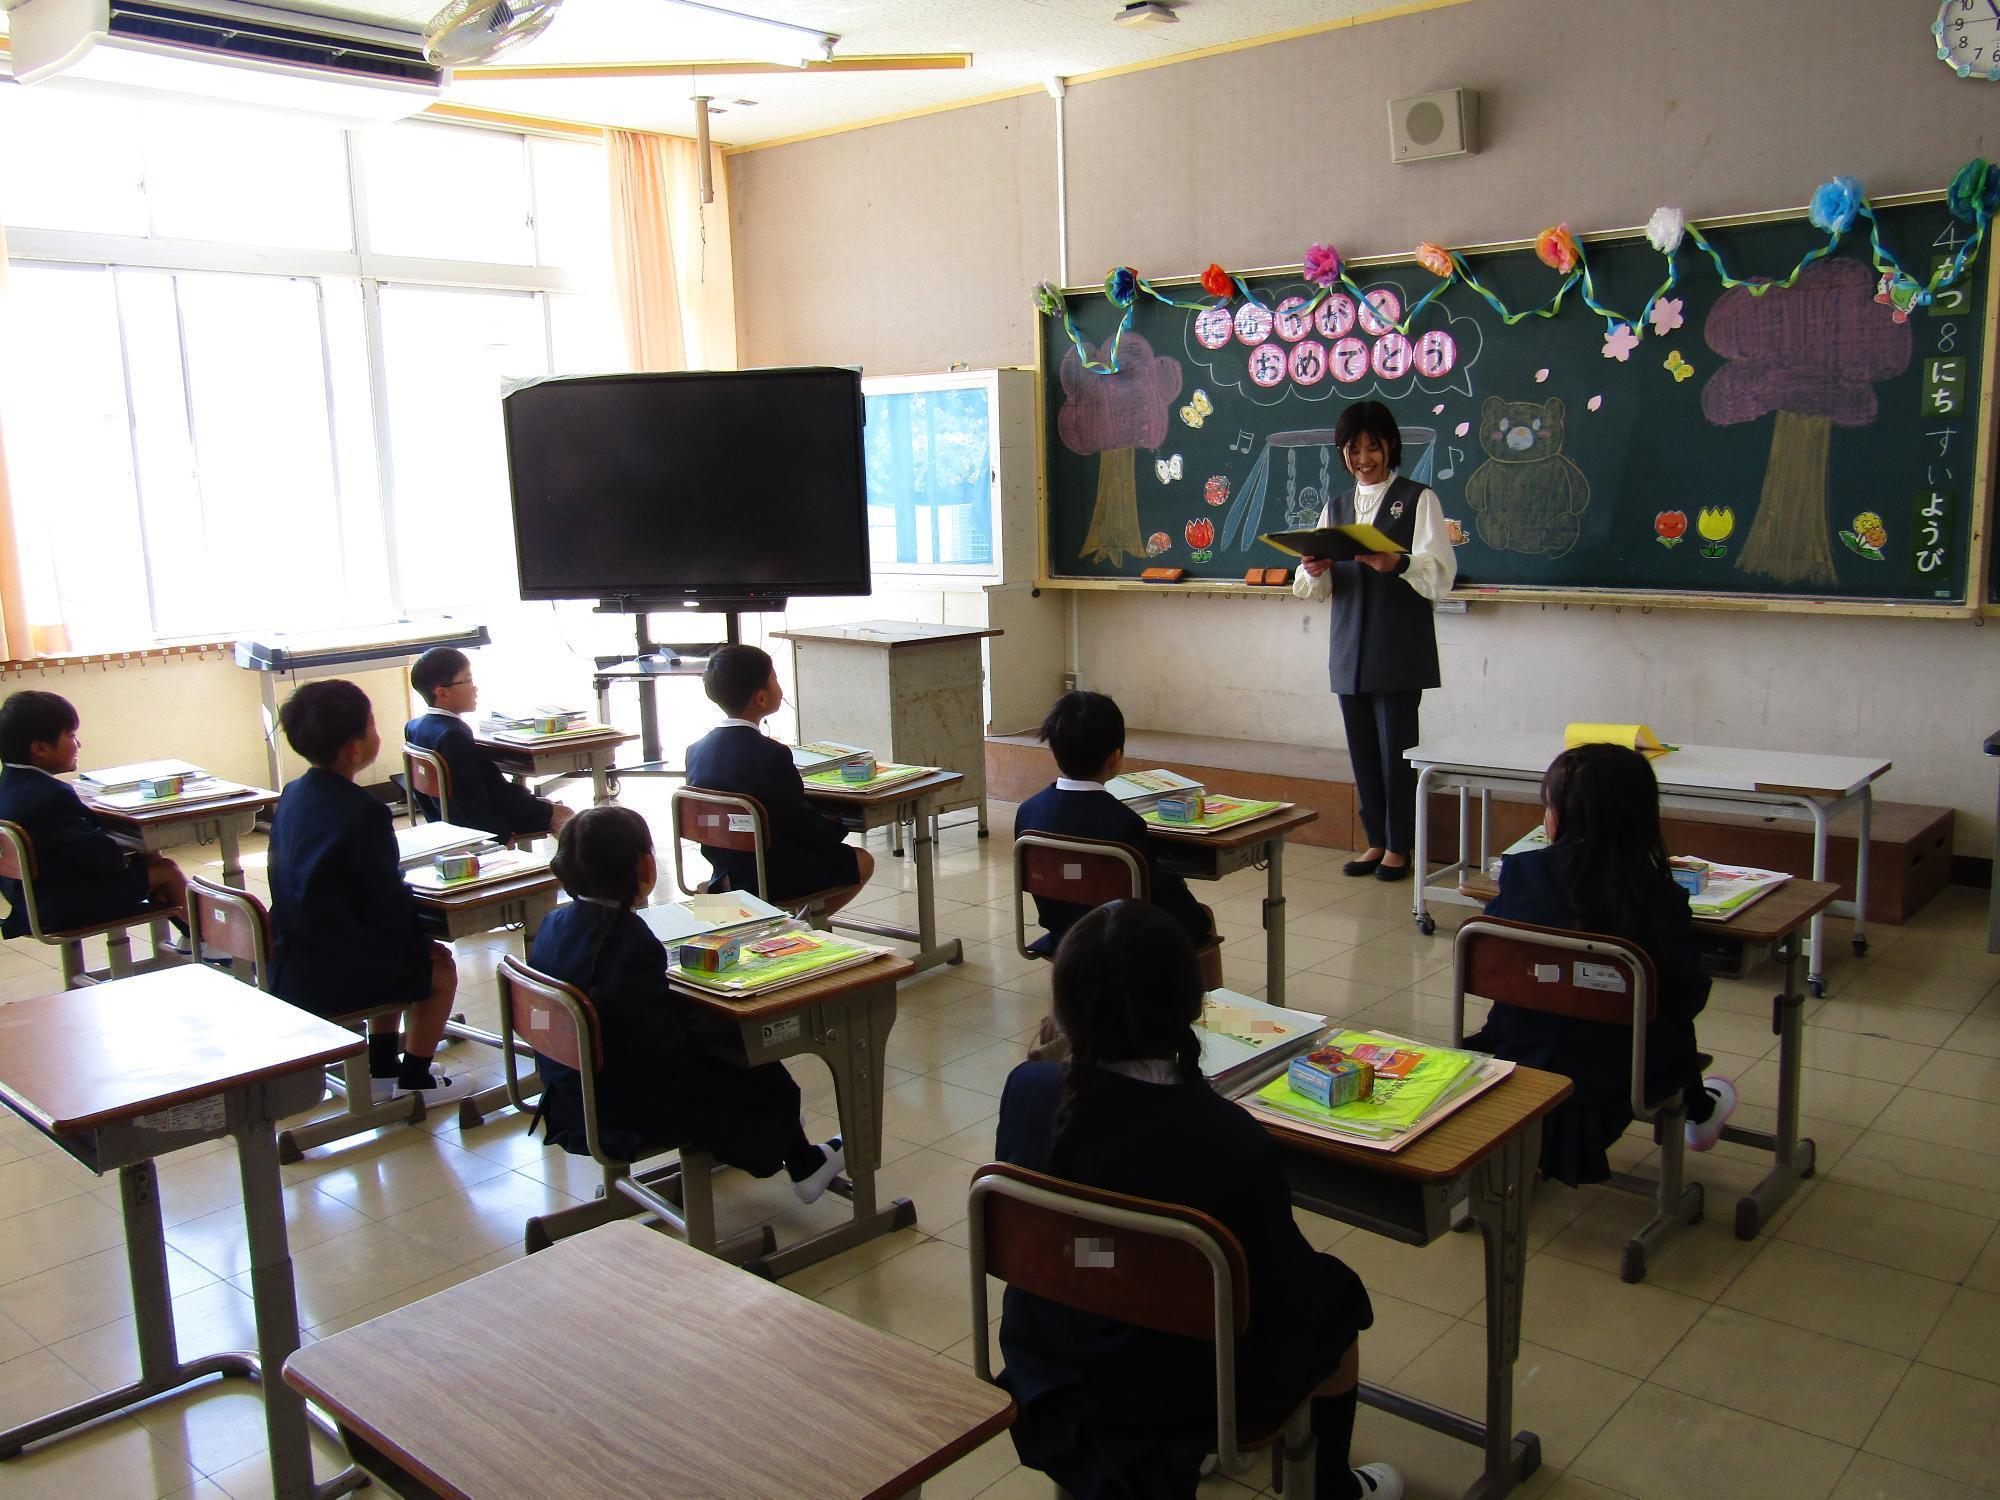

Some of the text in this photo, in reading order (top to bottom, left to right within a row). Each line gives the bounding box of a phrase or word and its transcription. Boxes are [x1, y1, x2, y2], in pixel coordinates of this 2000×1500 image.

[1961, 0, 1973, 11] 10
[1955, 18, 1964, 31] 9
[1959, 36, 1968, 48] 8
[1974, 48, 1983, 60] 7
[1992, 50, 2000, 62] 6
[1256, 339, 1443, 381] おめでとう
